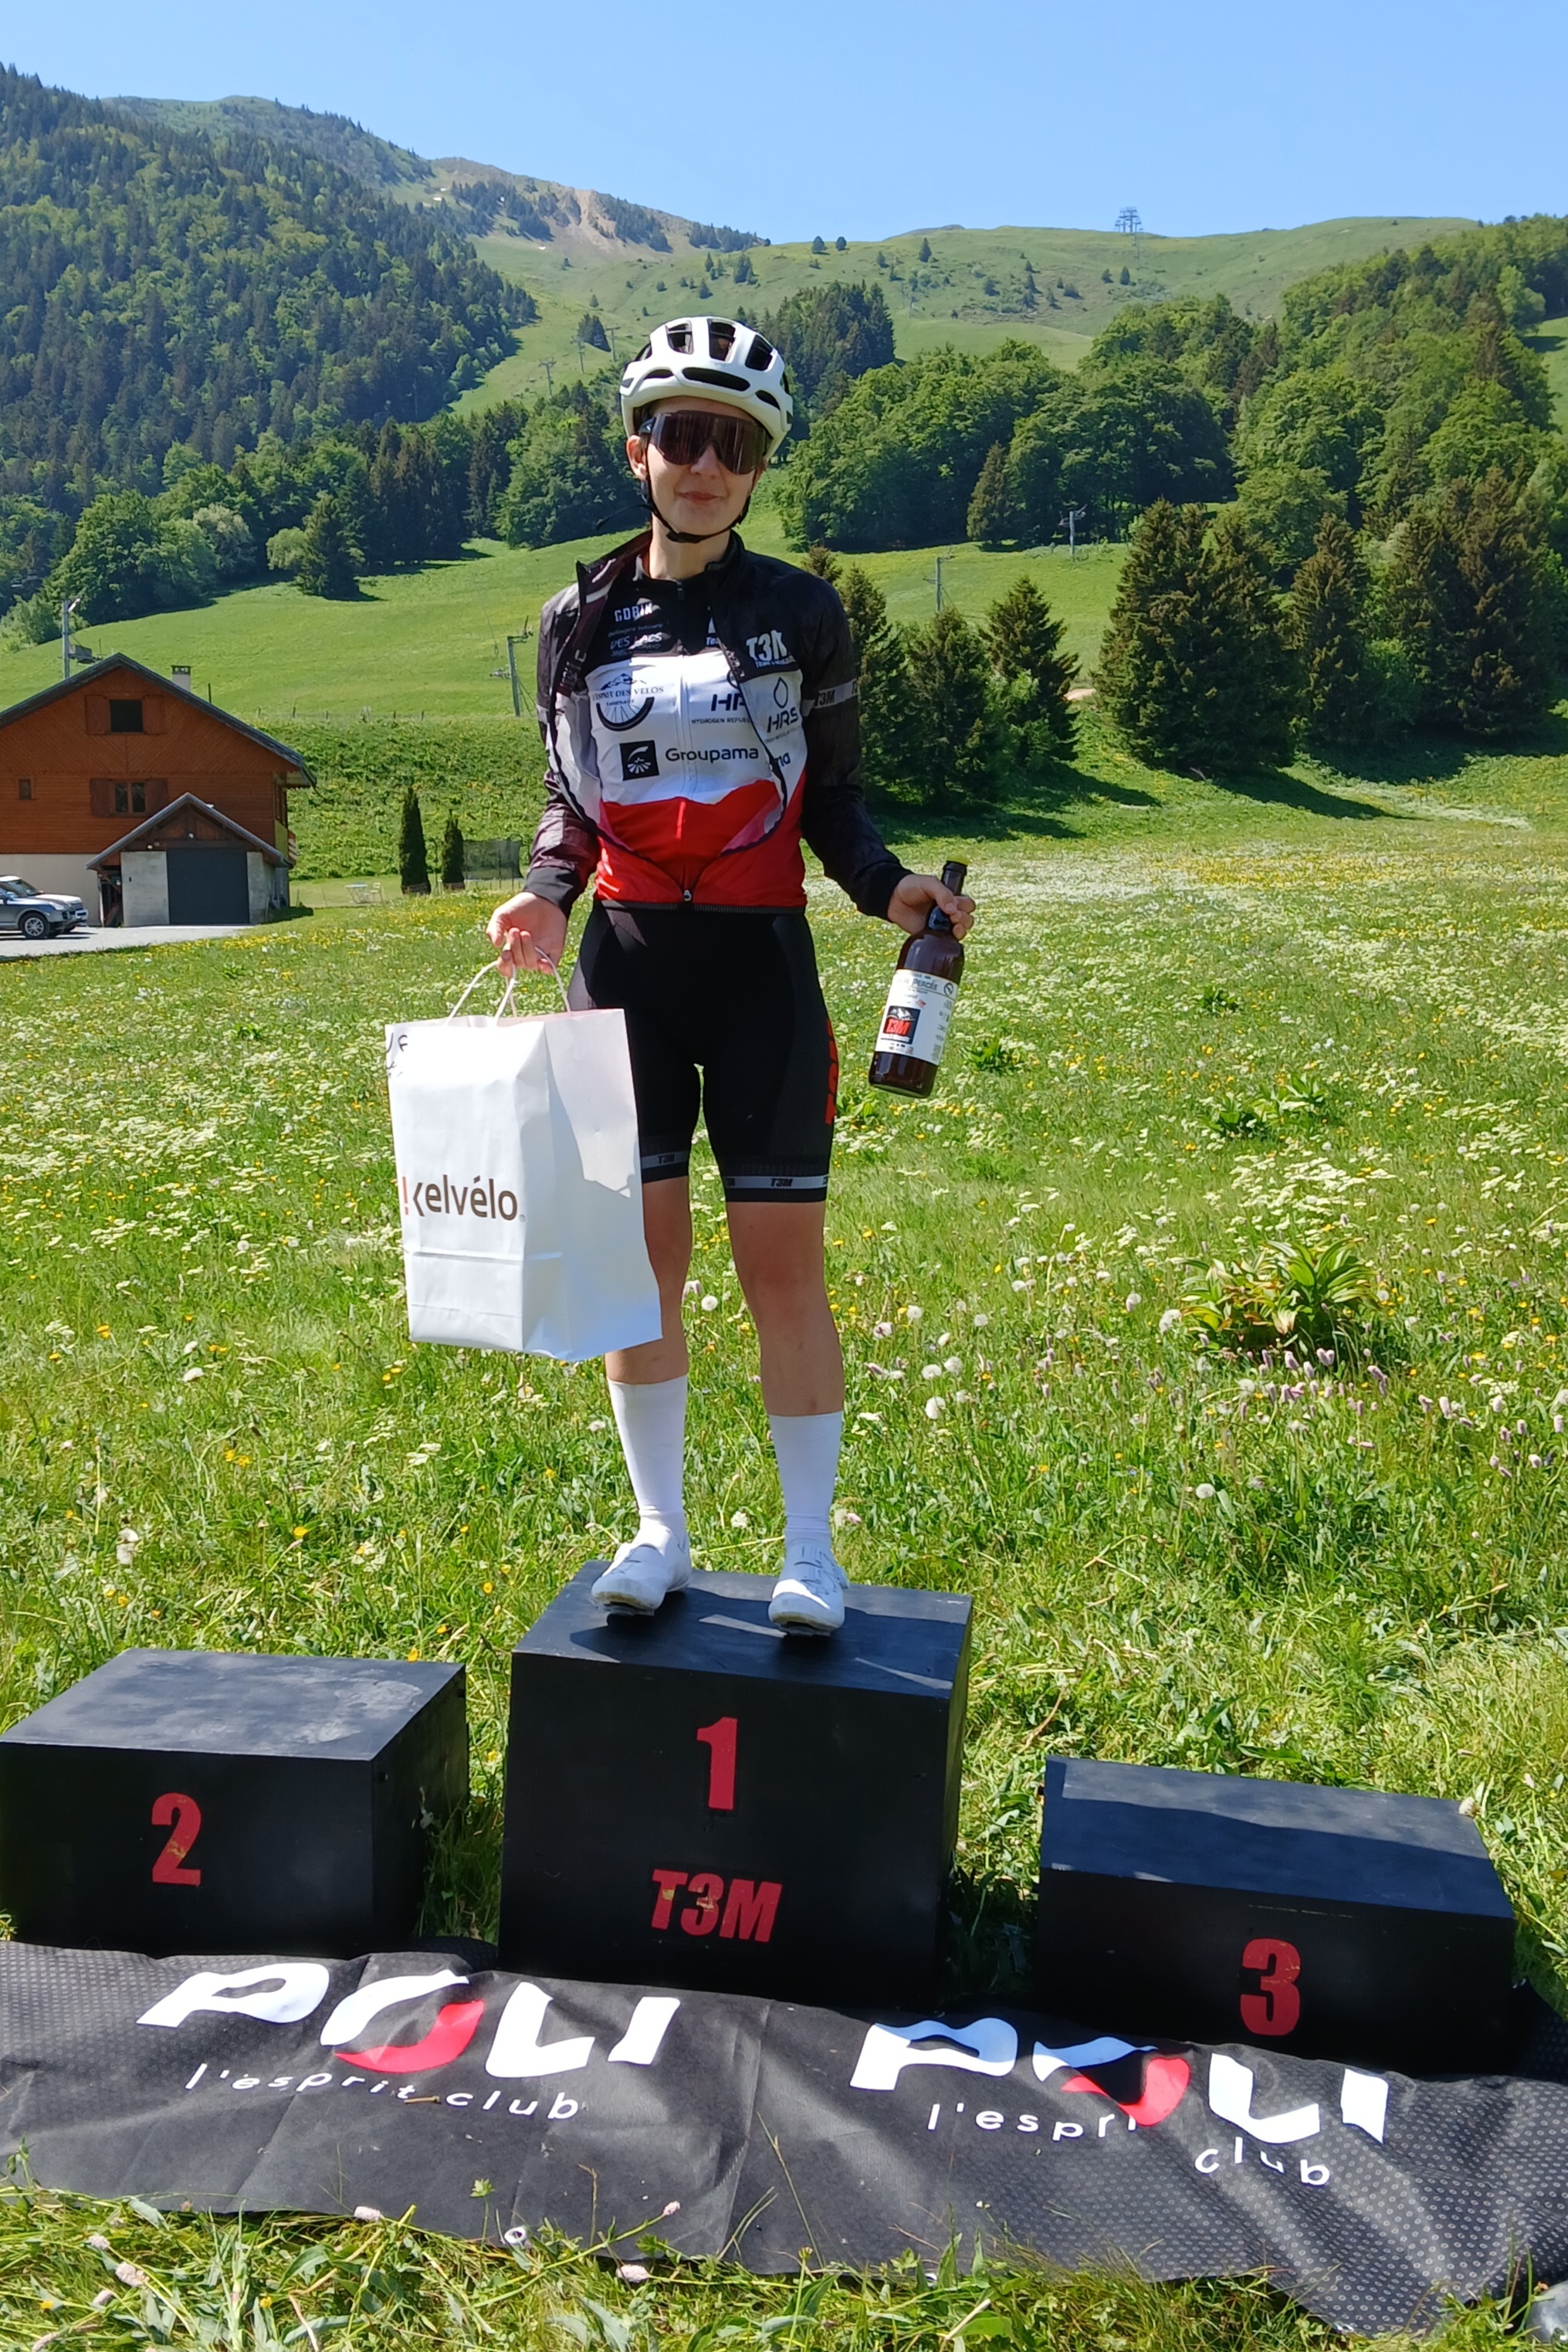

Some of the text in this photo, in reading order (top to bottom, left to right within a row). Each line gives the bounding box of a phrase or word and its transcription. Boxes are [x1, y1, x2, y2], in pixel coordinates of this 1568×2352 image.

[614, 602, 652, 622] GOBIK
[711, 693, 746, 711] HR
[767, 707, 799, 733] HRS
[665, 747, 759, 764] Groupama
[770, 1178, 794, 1187] T3M
[696, 1717, 738, 1811] 1
[151, 1791, 202, 1887] 2
[651, 1869, 783, 1944] T3M
[137, 1962, 681, 2078] POLI
[1239, 1938, 1301, 2036] 3
[185, 2063, 580, 2120] l'esprit club
[849, 2017, 1389, 2144] POLI
[926, 2103, 1330, 2187] l'espri club
